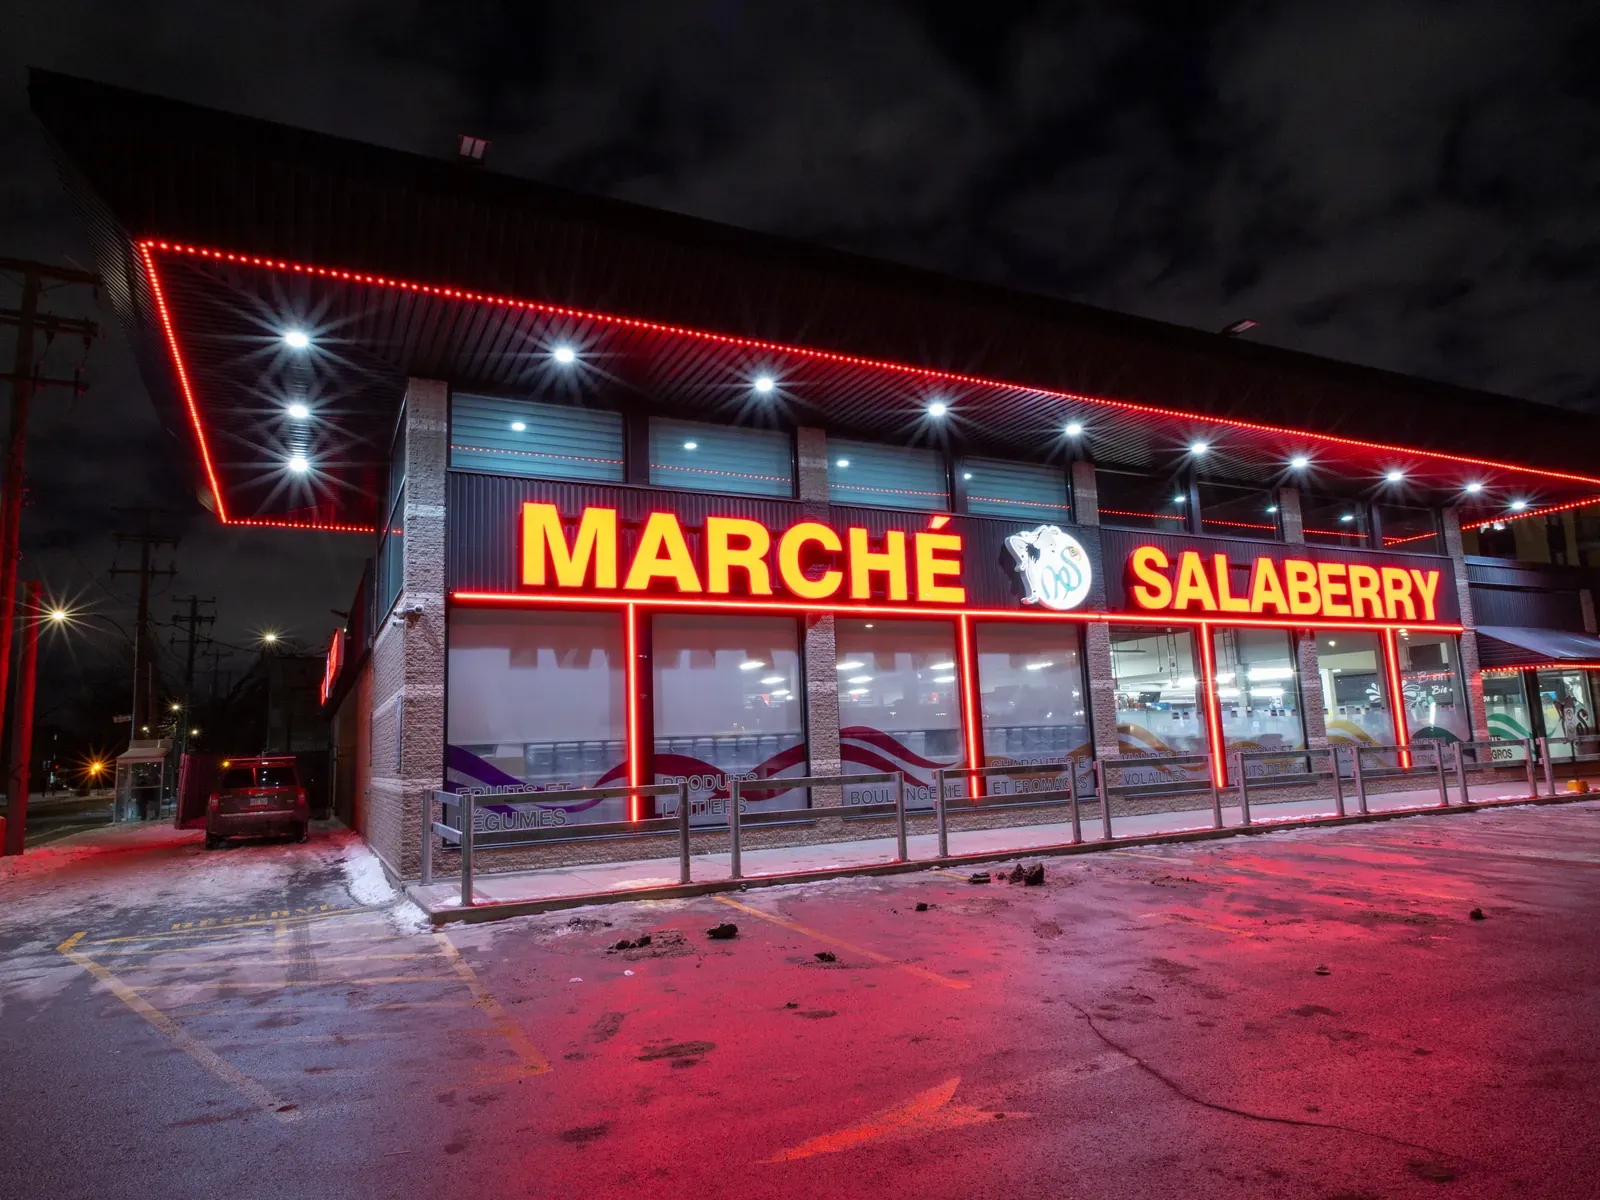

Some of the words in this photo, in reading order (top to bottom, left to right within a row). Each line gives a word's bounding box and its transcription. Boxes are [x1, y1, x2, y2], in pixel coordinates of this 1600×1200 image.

[521, 501, 967, 604] MARCHÉ
[1128, 545, 1440, 621] SALABERRY
[1492, 748, 1513, 760] GROS
[992, 781, 1010, 795] ET
[1014, 775, 1088, 793] FROMAGS
[1123, 769, 1187, 786] VOLAILLES
[850, 784, 962, 805] BOULNGEIE
[662, 797, 748, 819] LITIES
[456, 808, 566, 833] LÉGUMES
